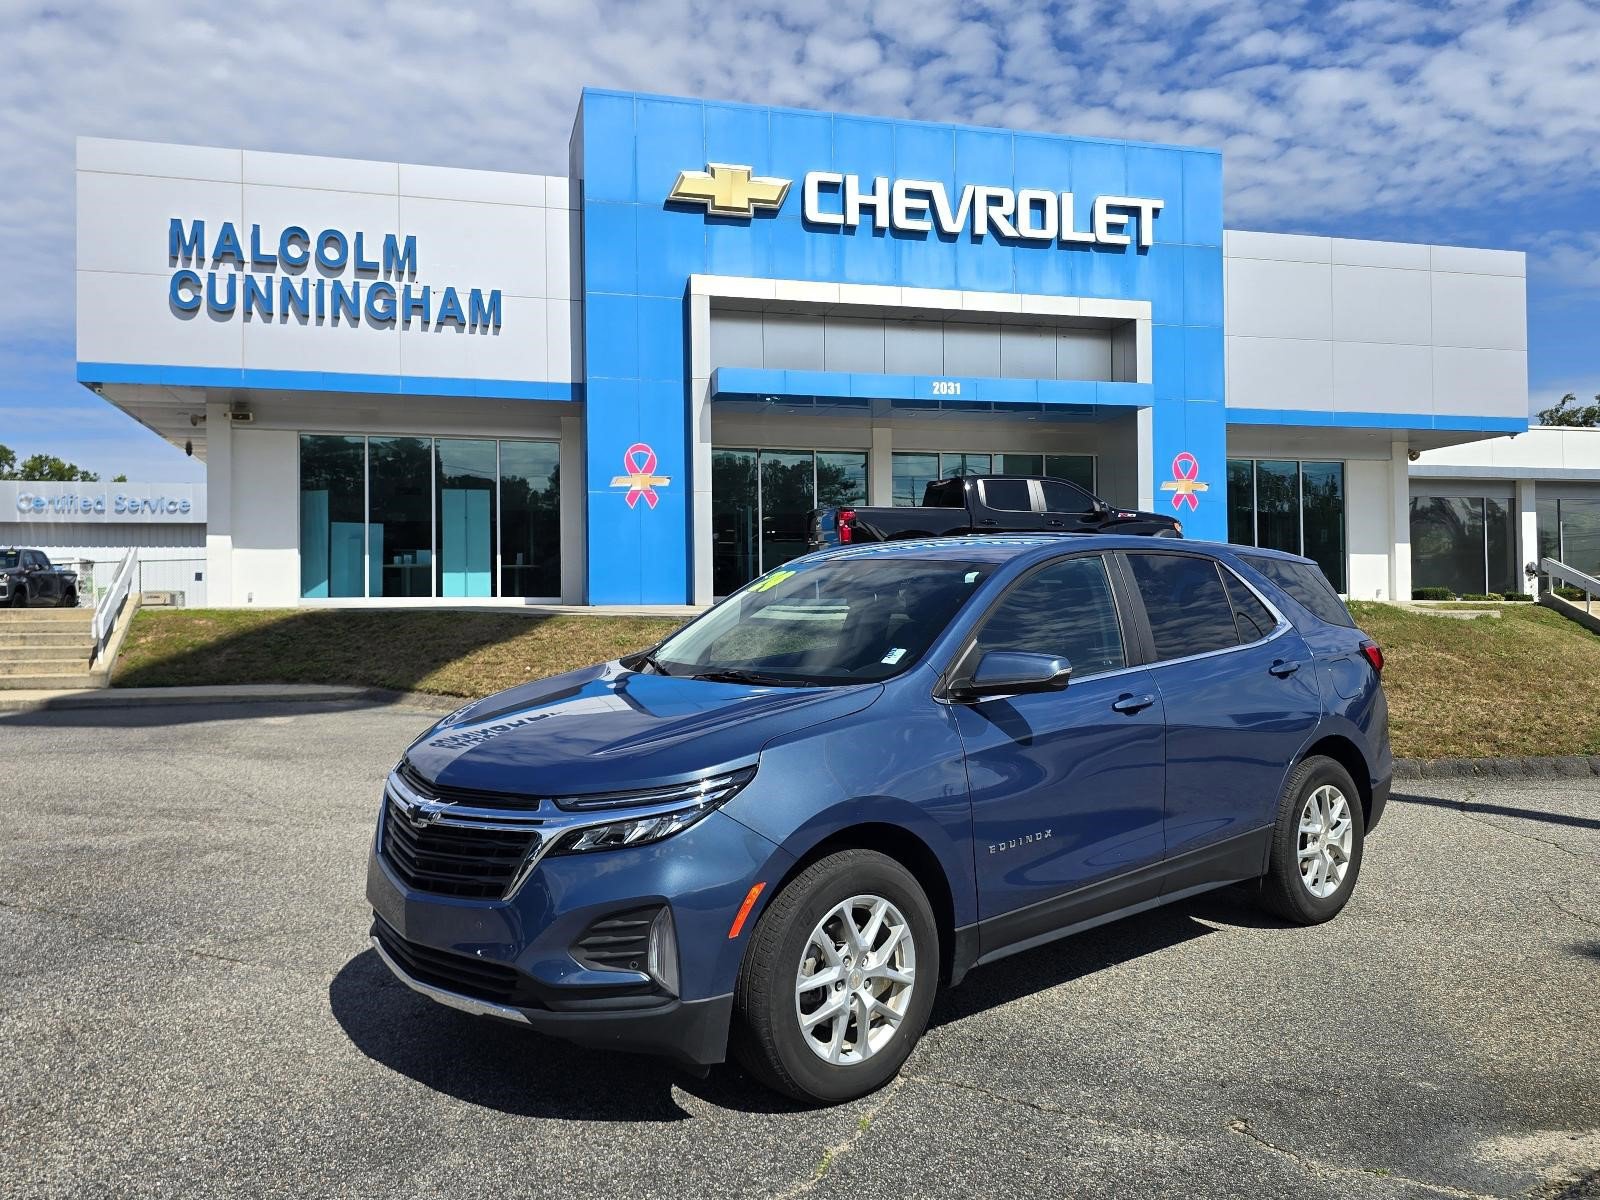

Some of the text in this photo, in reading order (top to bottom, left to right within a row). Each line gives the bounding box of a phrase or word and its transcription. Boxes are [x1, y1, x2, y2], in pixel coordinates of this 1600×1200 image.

[804, 171, 1165, 247] CHEVROLET
[168, 218, 417, 275] MALCOLM
[168, 269, 502, 330] CUNNINGHAM
[932, 381, 961, 395] 2031
[16, 492, 192, 515] Certified Service
[988, 829, 1052, 854] EQUINOX
